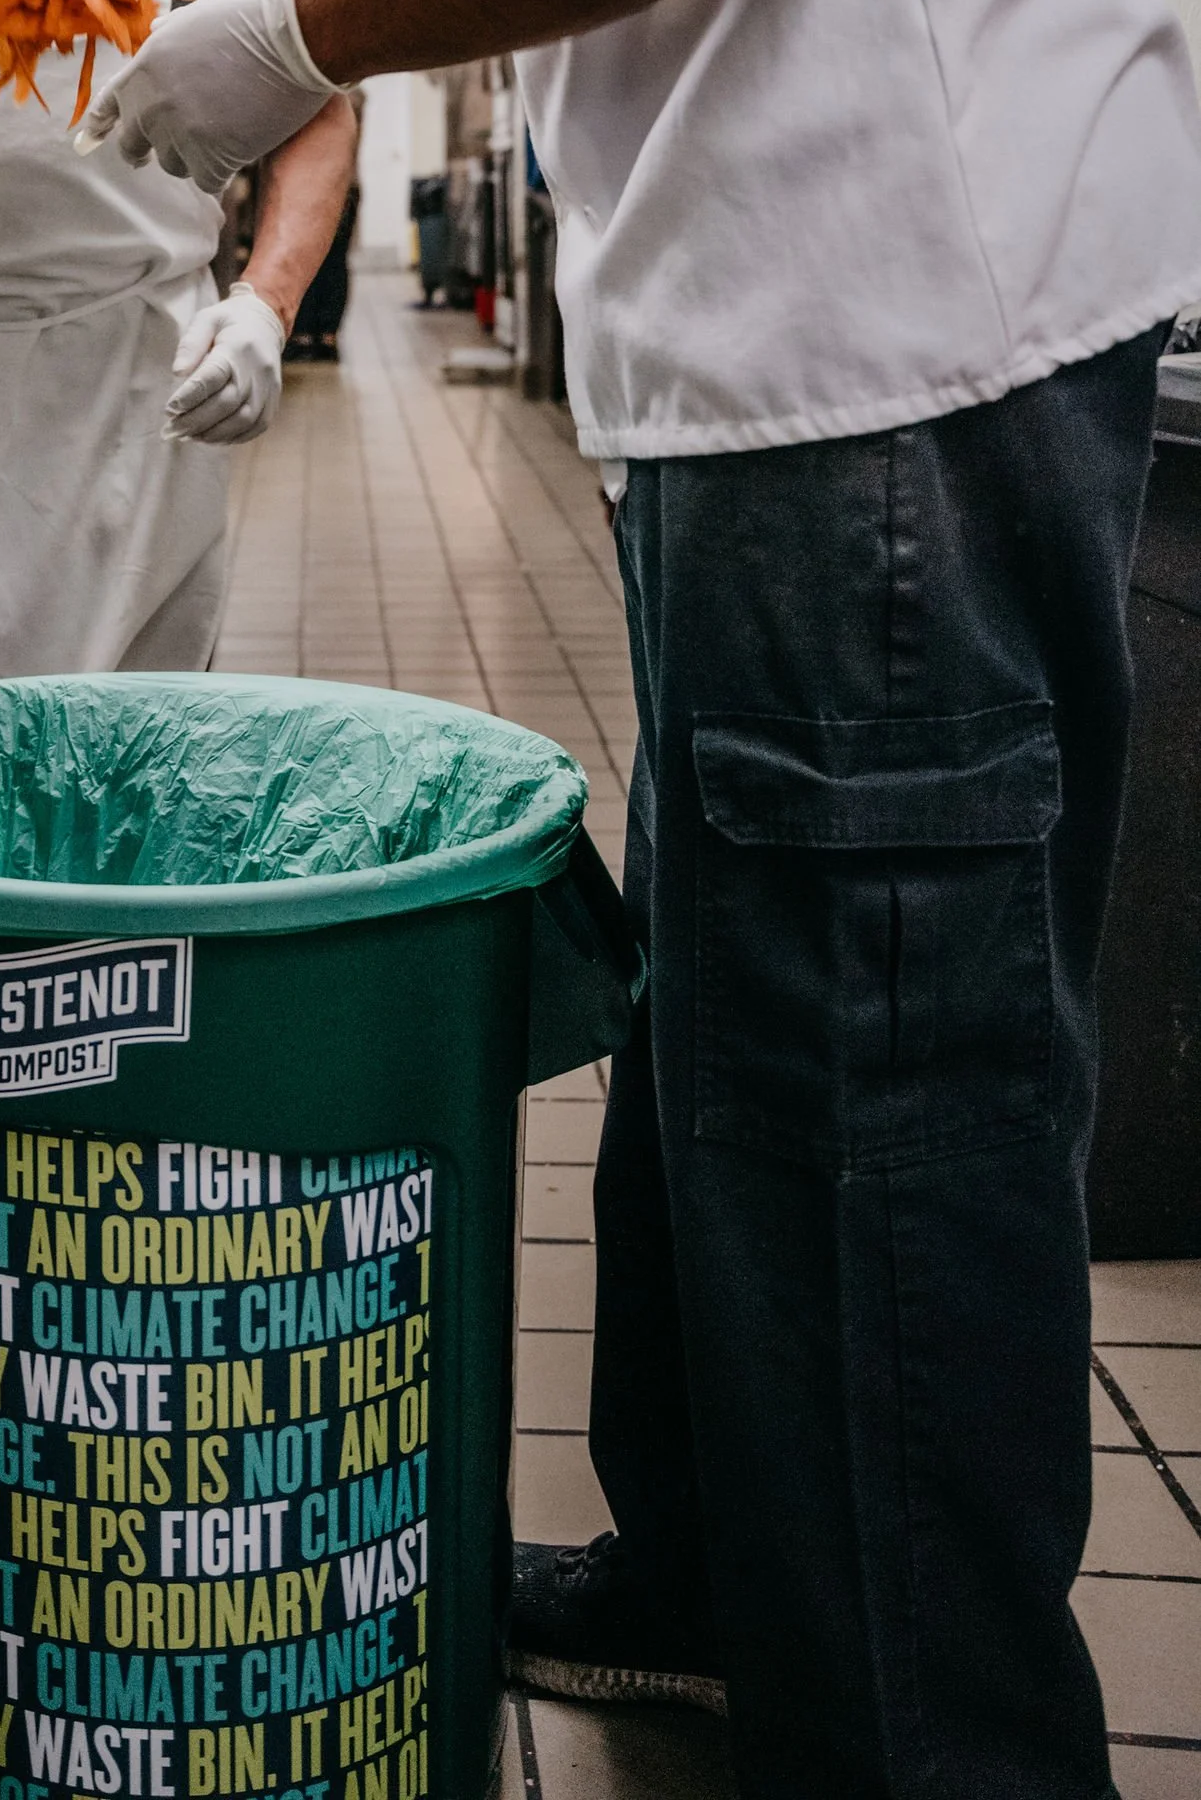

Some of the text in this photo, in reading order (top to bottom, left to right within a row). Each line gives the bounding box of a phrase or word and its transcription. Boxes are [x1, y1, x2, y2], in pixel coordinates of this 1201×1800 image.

[6, 1130, 144, 1212] HELPS
[27, 1217, 87, 1283] AN
[102, 1200, 332, 1286] ORDINARY
[31, 1277, 226, 1360] CLIMATE
[238, 1252, 407, 1354] CHANGE.
[19, 1351, 174, 1432] WASTE
[185, 1354, 276, 1432] BIN.
[289, 1345, 329, 1422] IT
[338, 1309, 430, 1408] HELP
[67, 1432, 172, 1506] THIS
[185, 1434, 229, 1505] IS
[242, 1418, 329, 1500] NOT
[338, 1398, 389, 1480] AN
[11, 1484, 146, 1577] HELPS
[159, 1501, 290, 1578] FIGHT
[31, 1575, 91, 1645] AN
[103, 1561, 331, 1650] ORDINARY
[36, 1642, 228, 1724] CLIMATE
[240, 1606, 406, 1720] CHANGE.
[23, 1708, 176, 1798] WASTE
[187, 1722, 278, 1797] BIN.
[290, 1707, 329, 1784] IT
[338, 1661, 428, 1769] HELP
